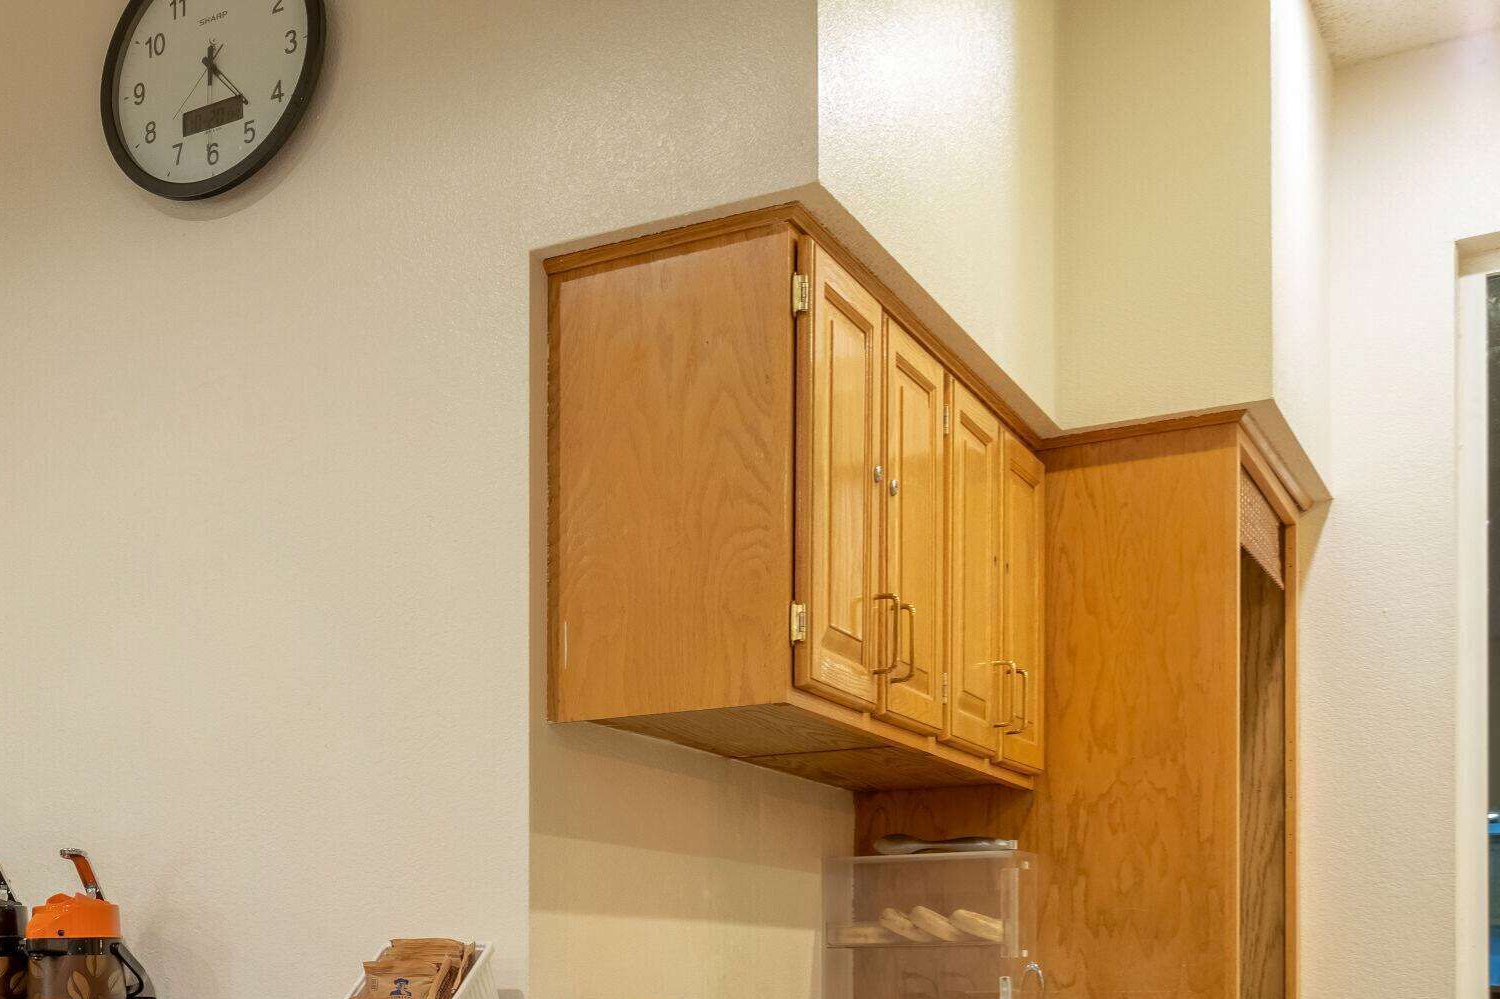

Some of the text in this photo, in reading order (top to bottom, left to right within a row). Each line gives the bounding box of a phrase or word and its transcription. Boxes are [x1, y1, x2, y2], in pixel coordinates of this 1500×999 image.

[199, 10, 228, 27] SHARP
[145, 33, 166, 58] 10
[284, 29, 298, 54] 3
[133, 82, 146, 106] 9
[270, 79, 285, 103] 4
[144, 121, 157, 144] 8
[243, 120, 256, 144] 5
[172, 142, 183, 166] 7
[207, 142, 219, 165] 6
